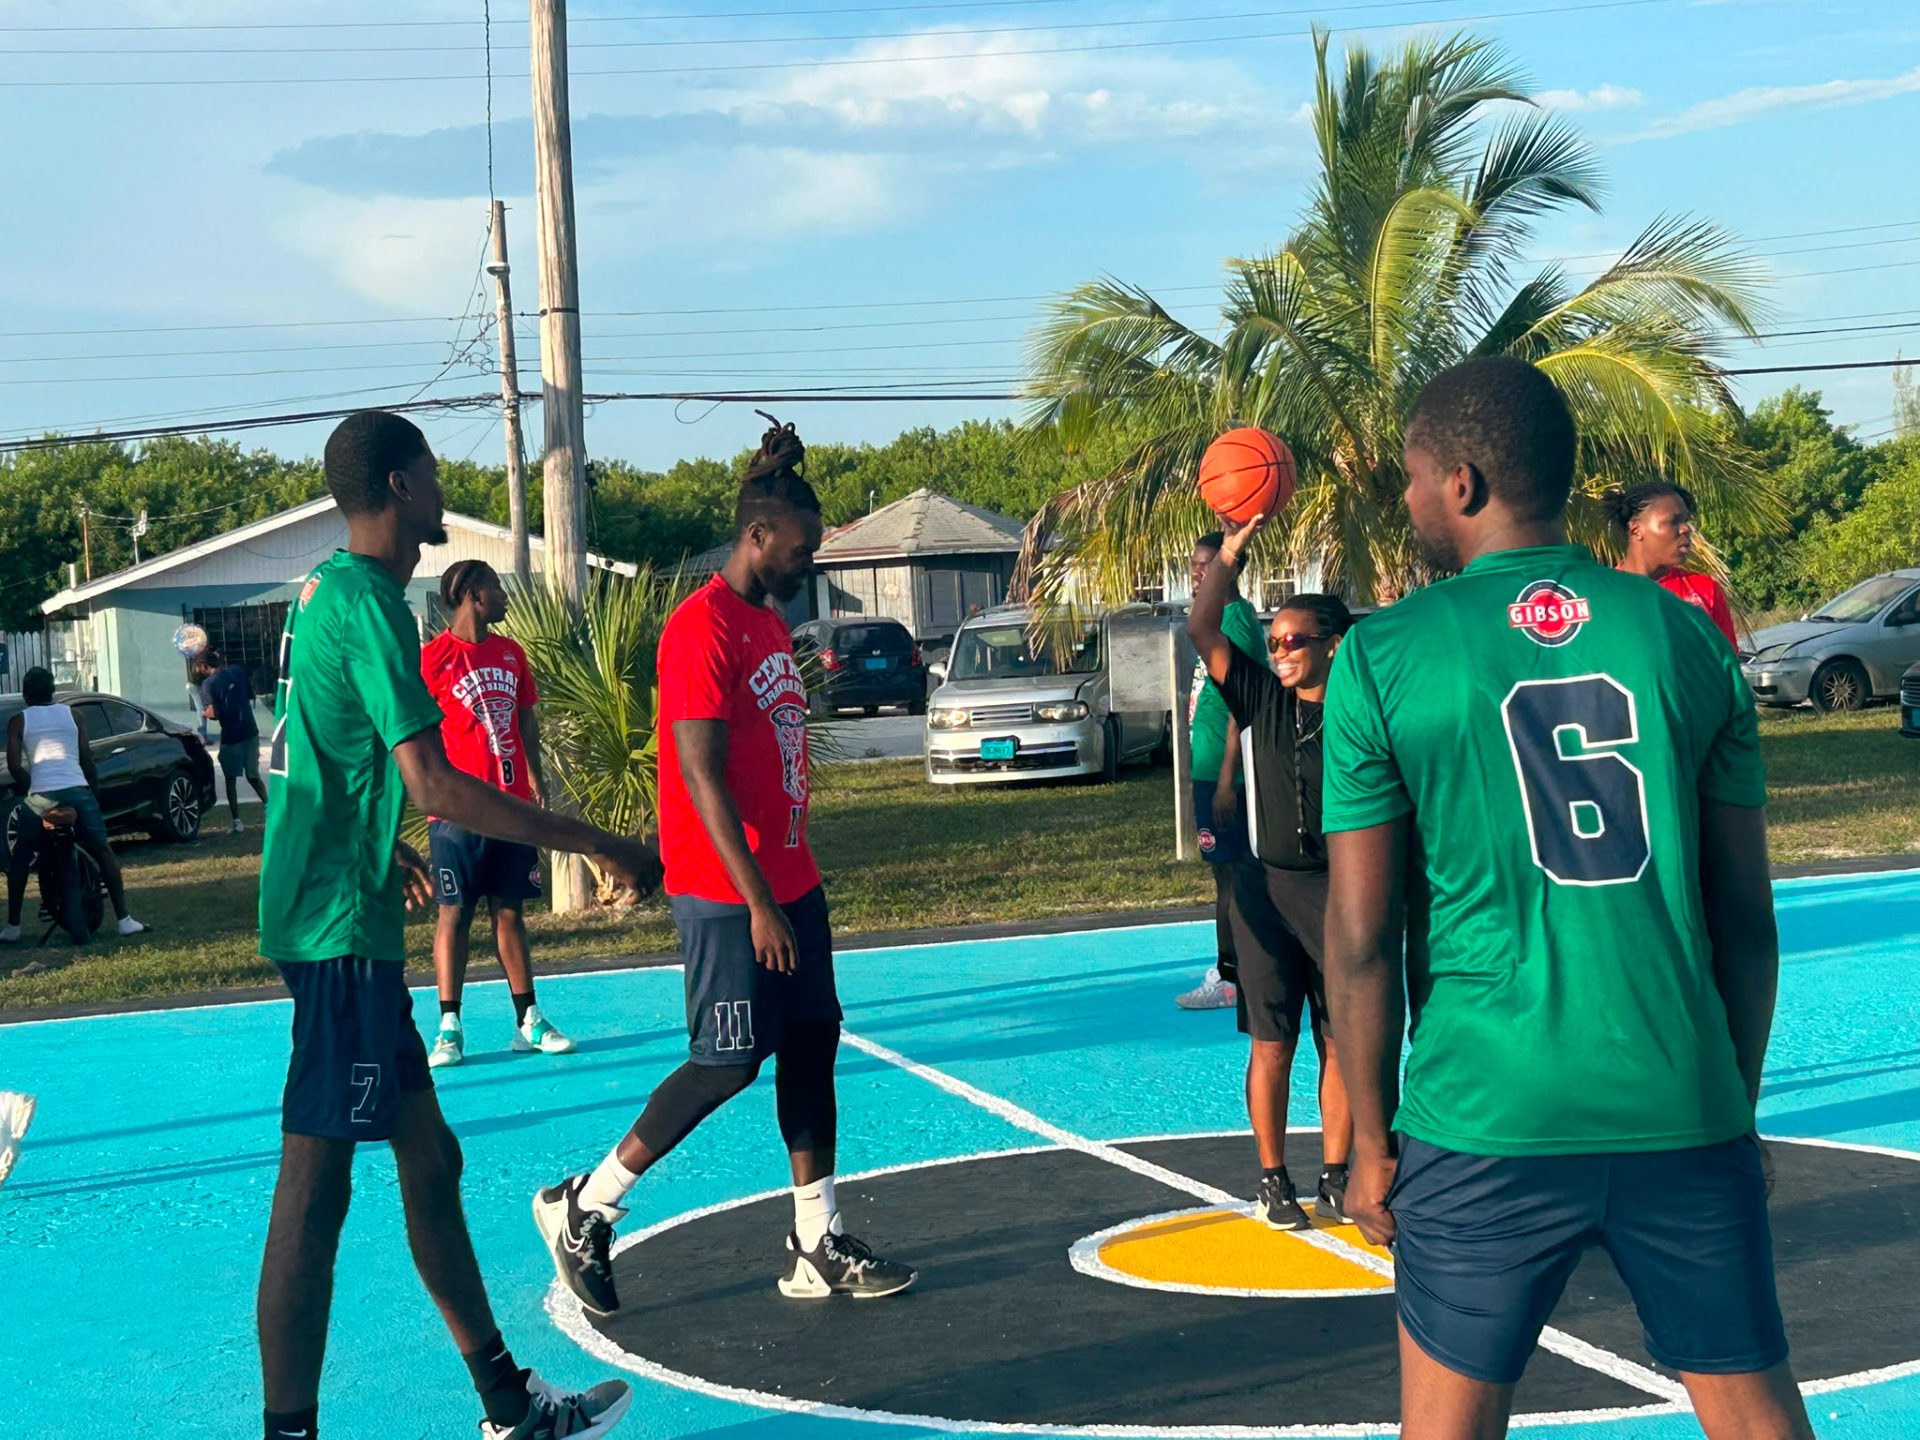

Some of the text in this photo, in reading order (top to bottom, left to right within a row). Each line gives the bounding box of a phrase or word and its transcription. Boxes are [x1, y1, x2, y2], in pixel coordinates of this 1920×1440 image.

[1509, 600, 1591, 624] GIBSON
[1500, 671, 1651, 887] 6
[714, 1000, 755, 1051] 11
[350, 1062, 381, 1123] 7
